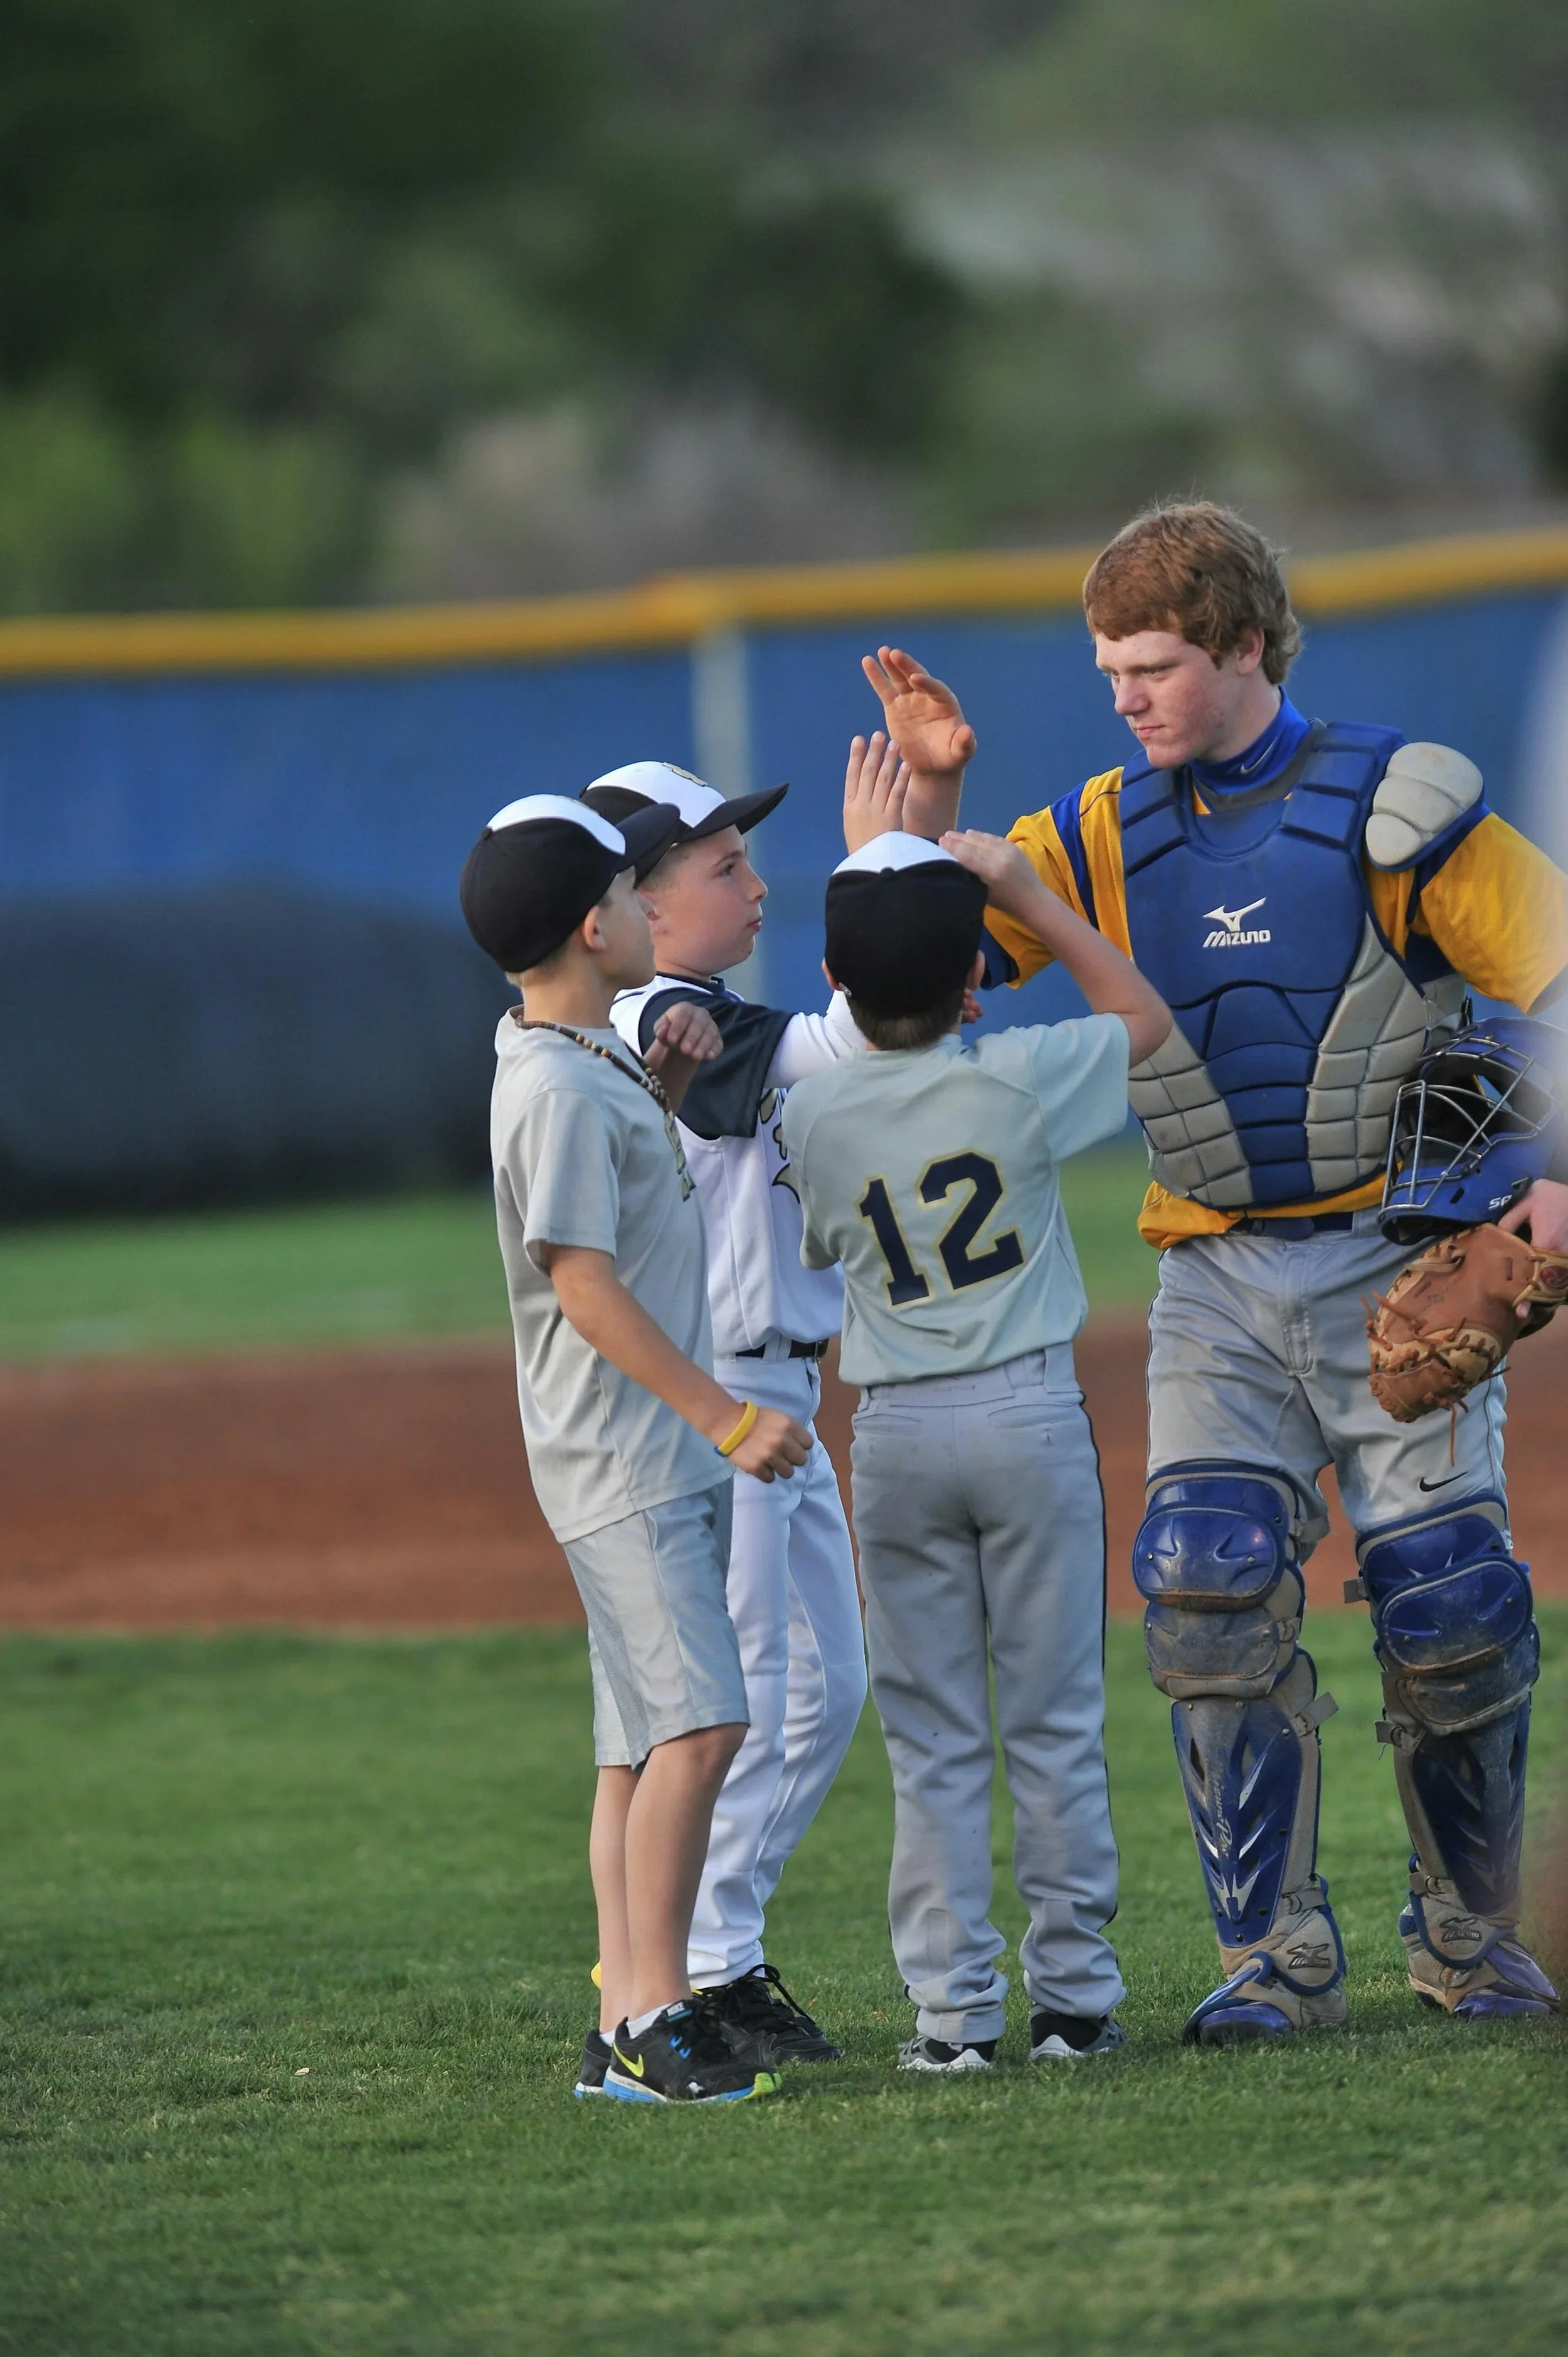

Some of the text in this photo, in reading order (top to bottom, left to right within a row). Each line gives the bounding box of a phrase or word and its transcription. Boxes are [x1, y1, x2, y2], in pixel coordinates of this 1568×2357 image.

[1202, 930, 1271, 948] MIZUNO
[856, 1148, 1026, 1309] 12
[1216, 1817, 1232, 1860] Pro
